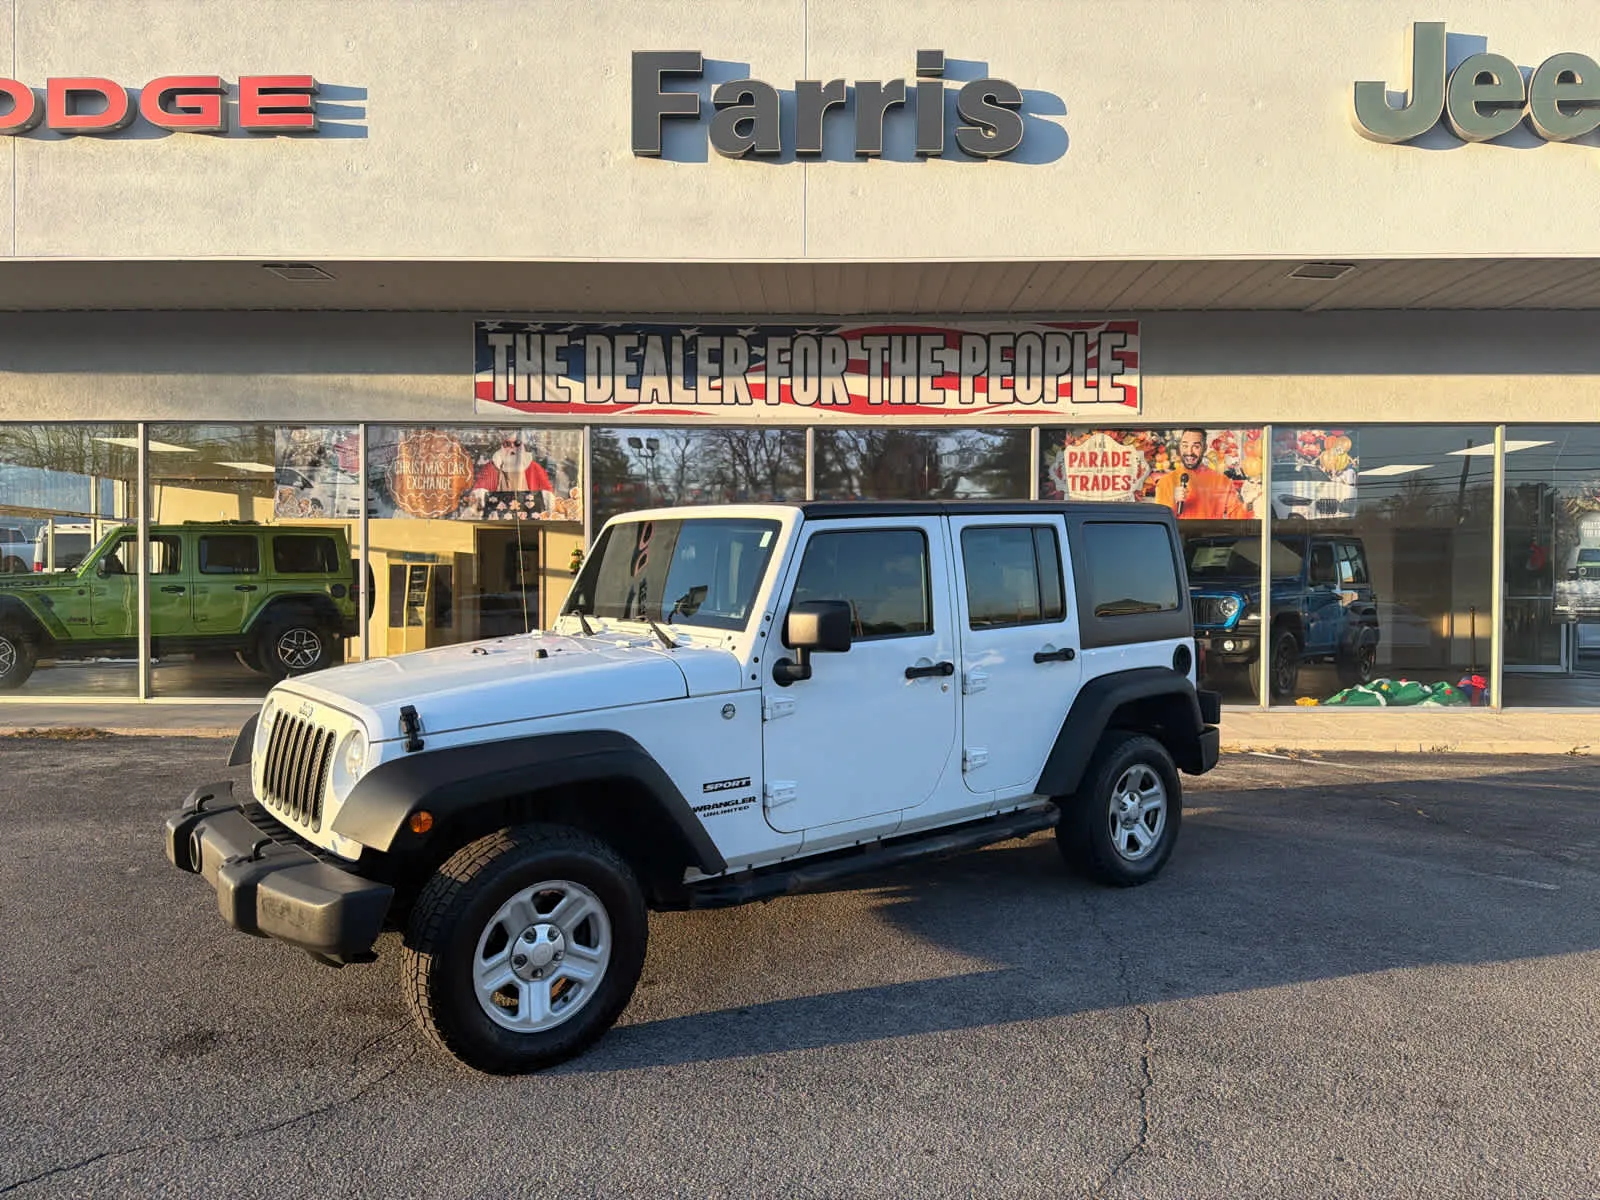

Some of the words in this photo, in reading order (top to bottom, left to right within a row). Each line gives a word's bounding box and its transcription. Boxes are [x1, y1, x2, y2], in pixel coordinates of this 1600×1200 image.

[631, 50, 1024, 158] Farris
[486, 332, 572, 403] THE
[583, 333, 753, 405] DEALER
[765, 333, 850, 406] FOR
[861, 333, 946, 405] THE
[959, 331, 1128, 405] PEOPLE
[395, 461, 445, 475] CHRISTMAS
[447, 461, 466, 475] CAR
[1068, 451, 1132, 468] PARADE
[406, 475, 452, 490] EXCHANGE
[1068, 474, 1132, 491] TRADES
[704, 779, 748, 791] SPORT
[692, 796, 757, 813] WRANGLER
[703, 805, 750, 818] UNLIMITED
